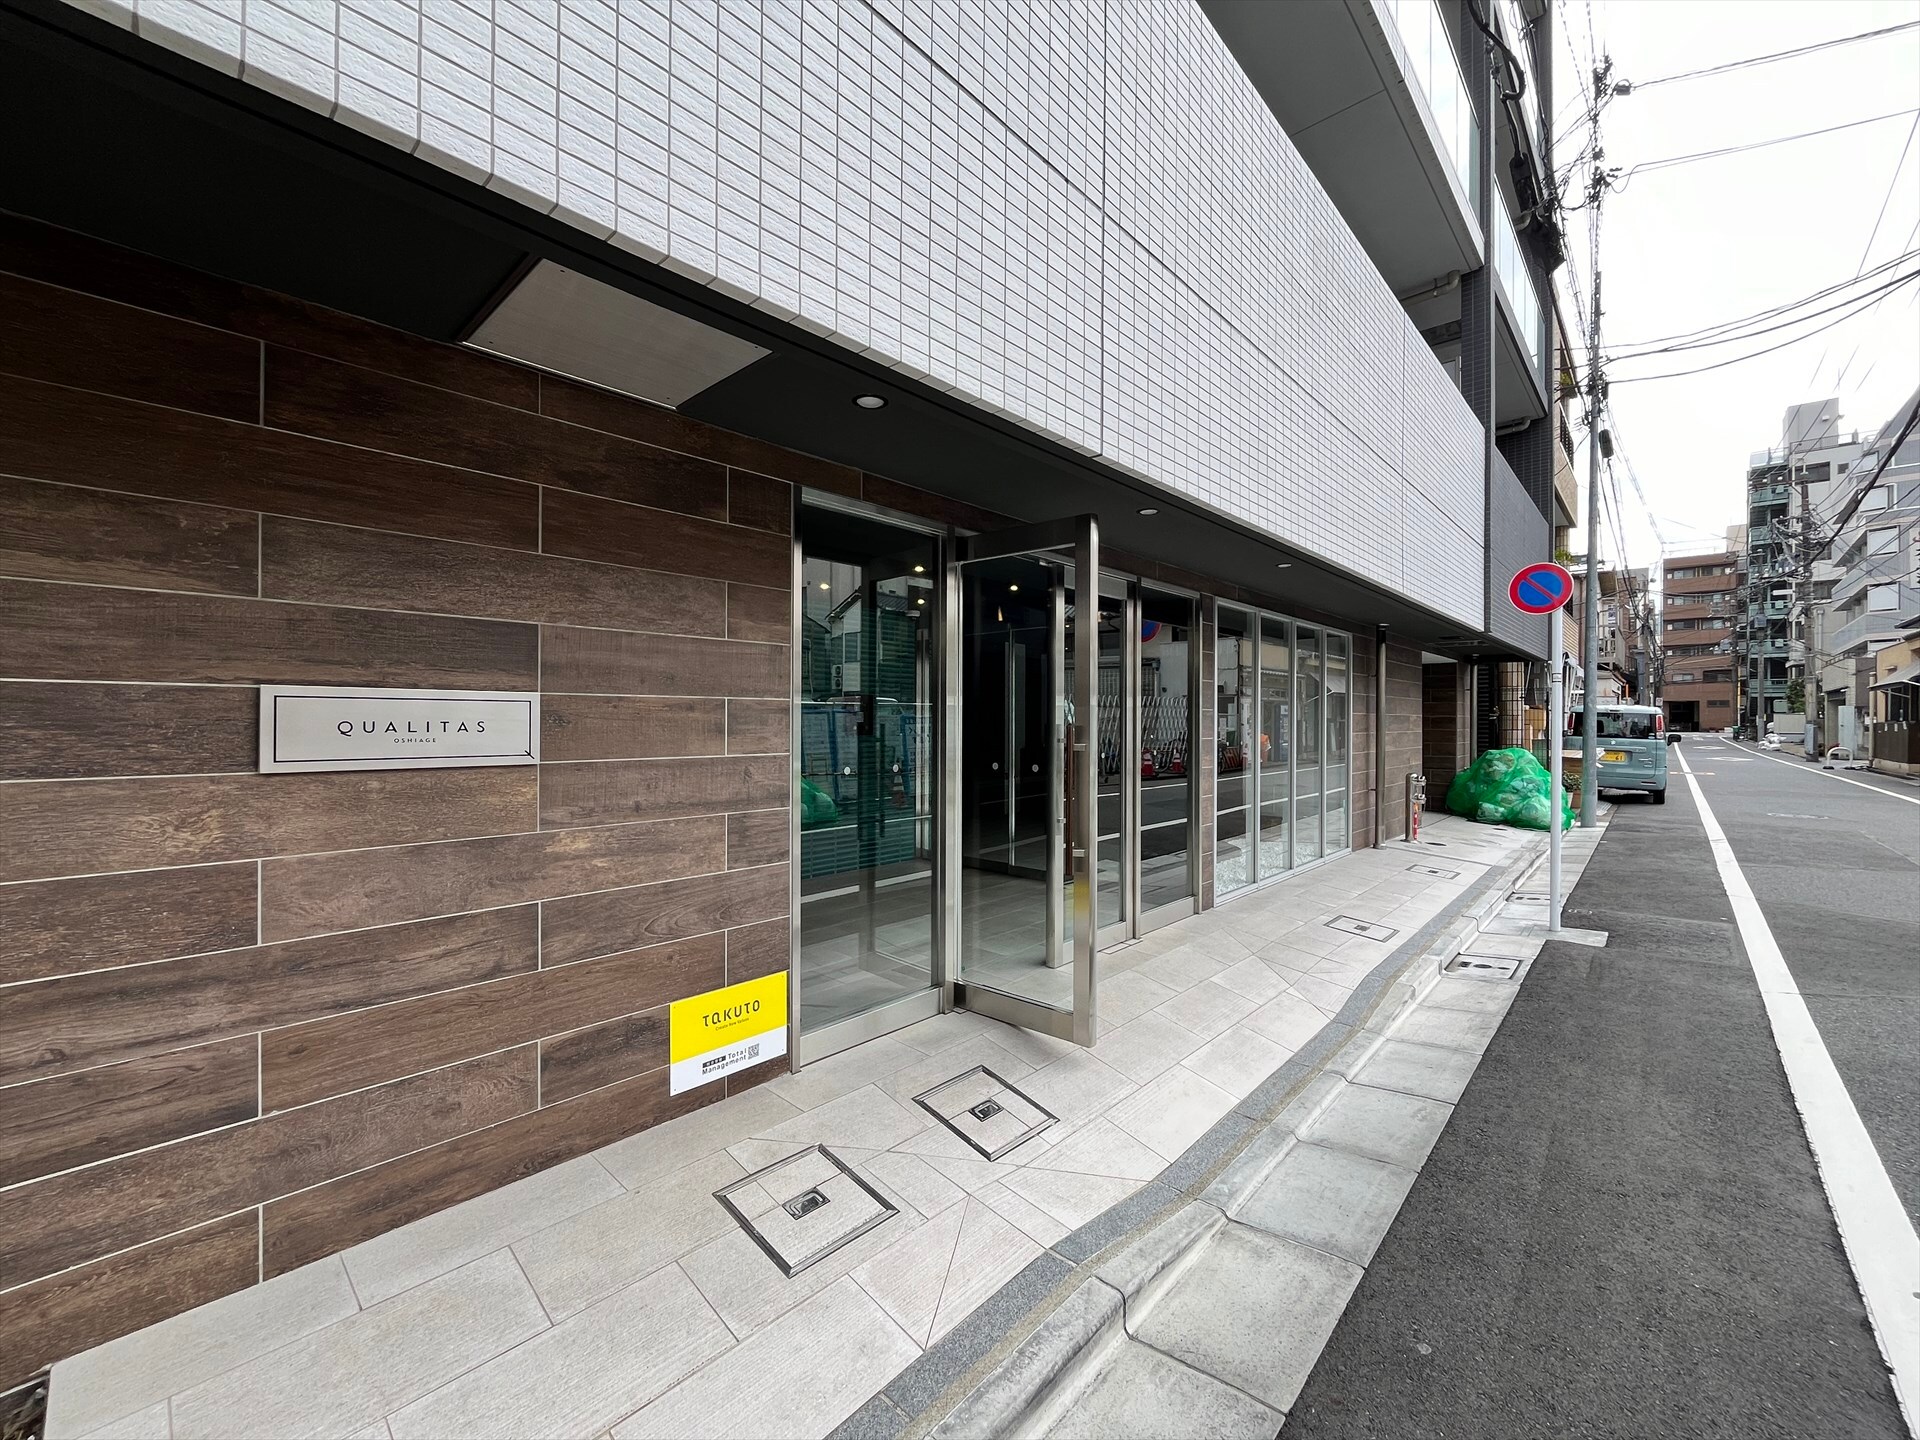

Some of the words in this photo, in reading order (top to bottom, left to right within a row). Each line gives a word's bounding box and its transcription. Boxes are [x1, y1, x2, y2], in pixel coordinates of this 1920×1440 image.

[337, 720, 487, 737] QUALITAS
[727, 1047, 747, 1060] Total
[702, 1055, 747, 1075] Management
